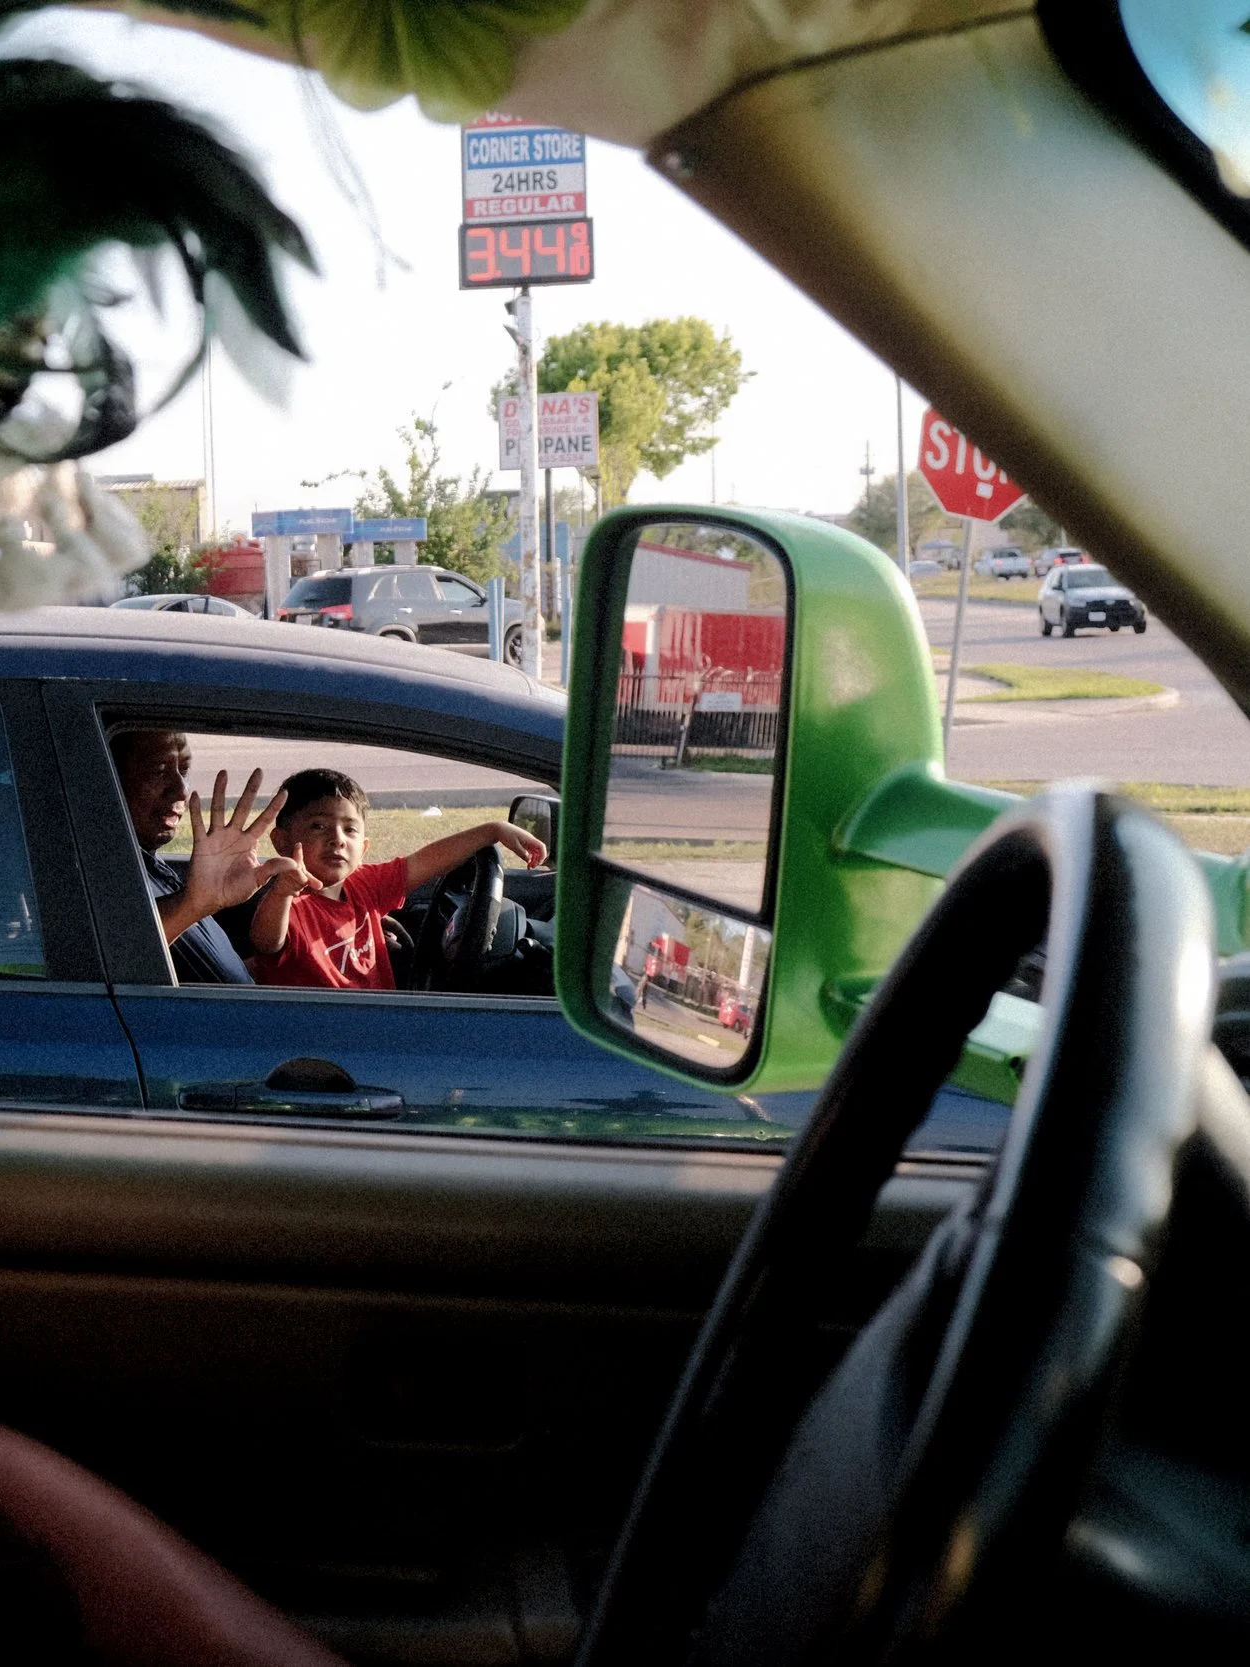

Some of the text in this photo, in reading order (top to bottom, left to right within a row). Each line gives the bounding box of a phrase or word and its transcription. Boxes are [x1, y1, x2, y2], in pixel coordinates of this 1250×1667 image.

[468, 133, 582, 165] CORNER STORE
[492, 171, 558, 193] 24HRS
[474, 196, 576, 216] REGULAR
[505, 436, 593, 456] PPANE
